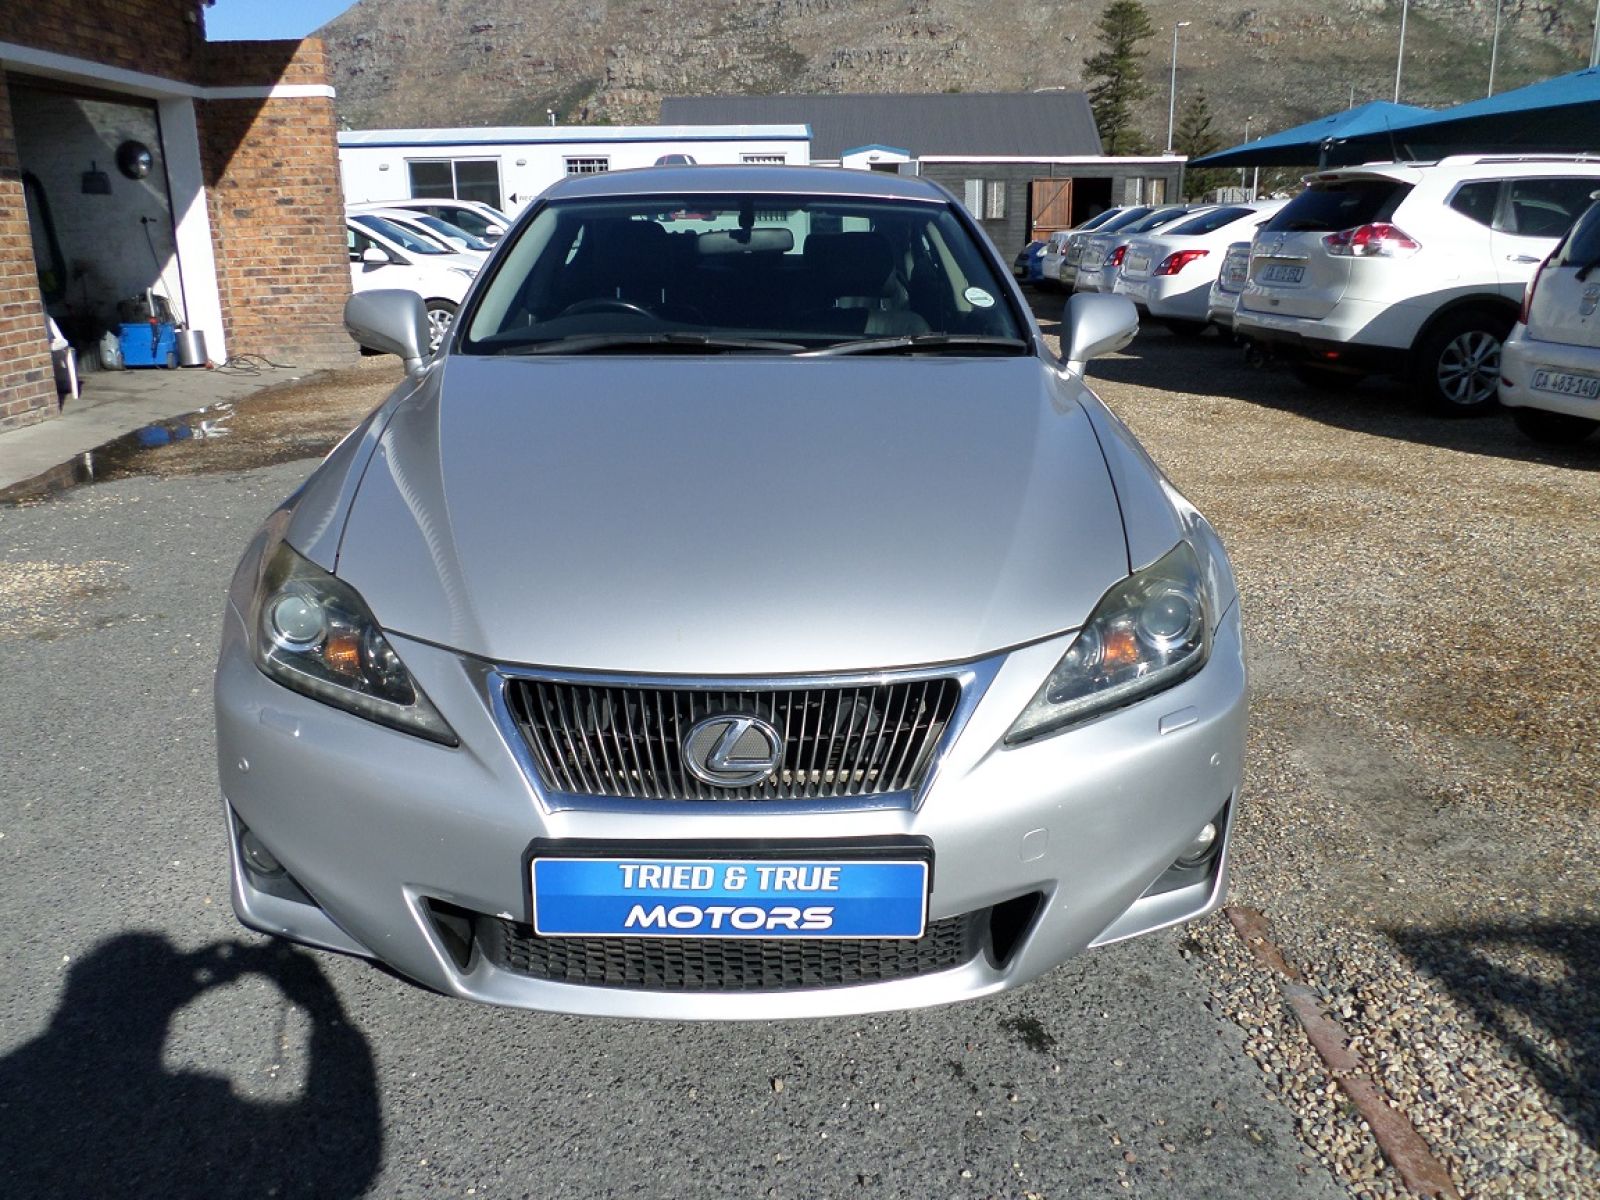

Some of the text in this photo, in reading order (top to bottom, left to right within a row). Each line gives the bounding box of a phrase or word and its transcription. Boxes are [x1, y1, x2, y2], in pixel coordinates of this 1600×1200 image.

[619, 864, 841, 891] TRIED & TRUE
[624, 904, 835, 930] MOTORS
